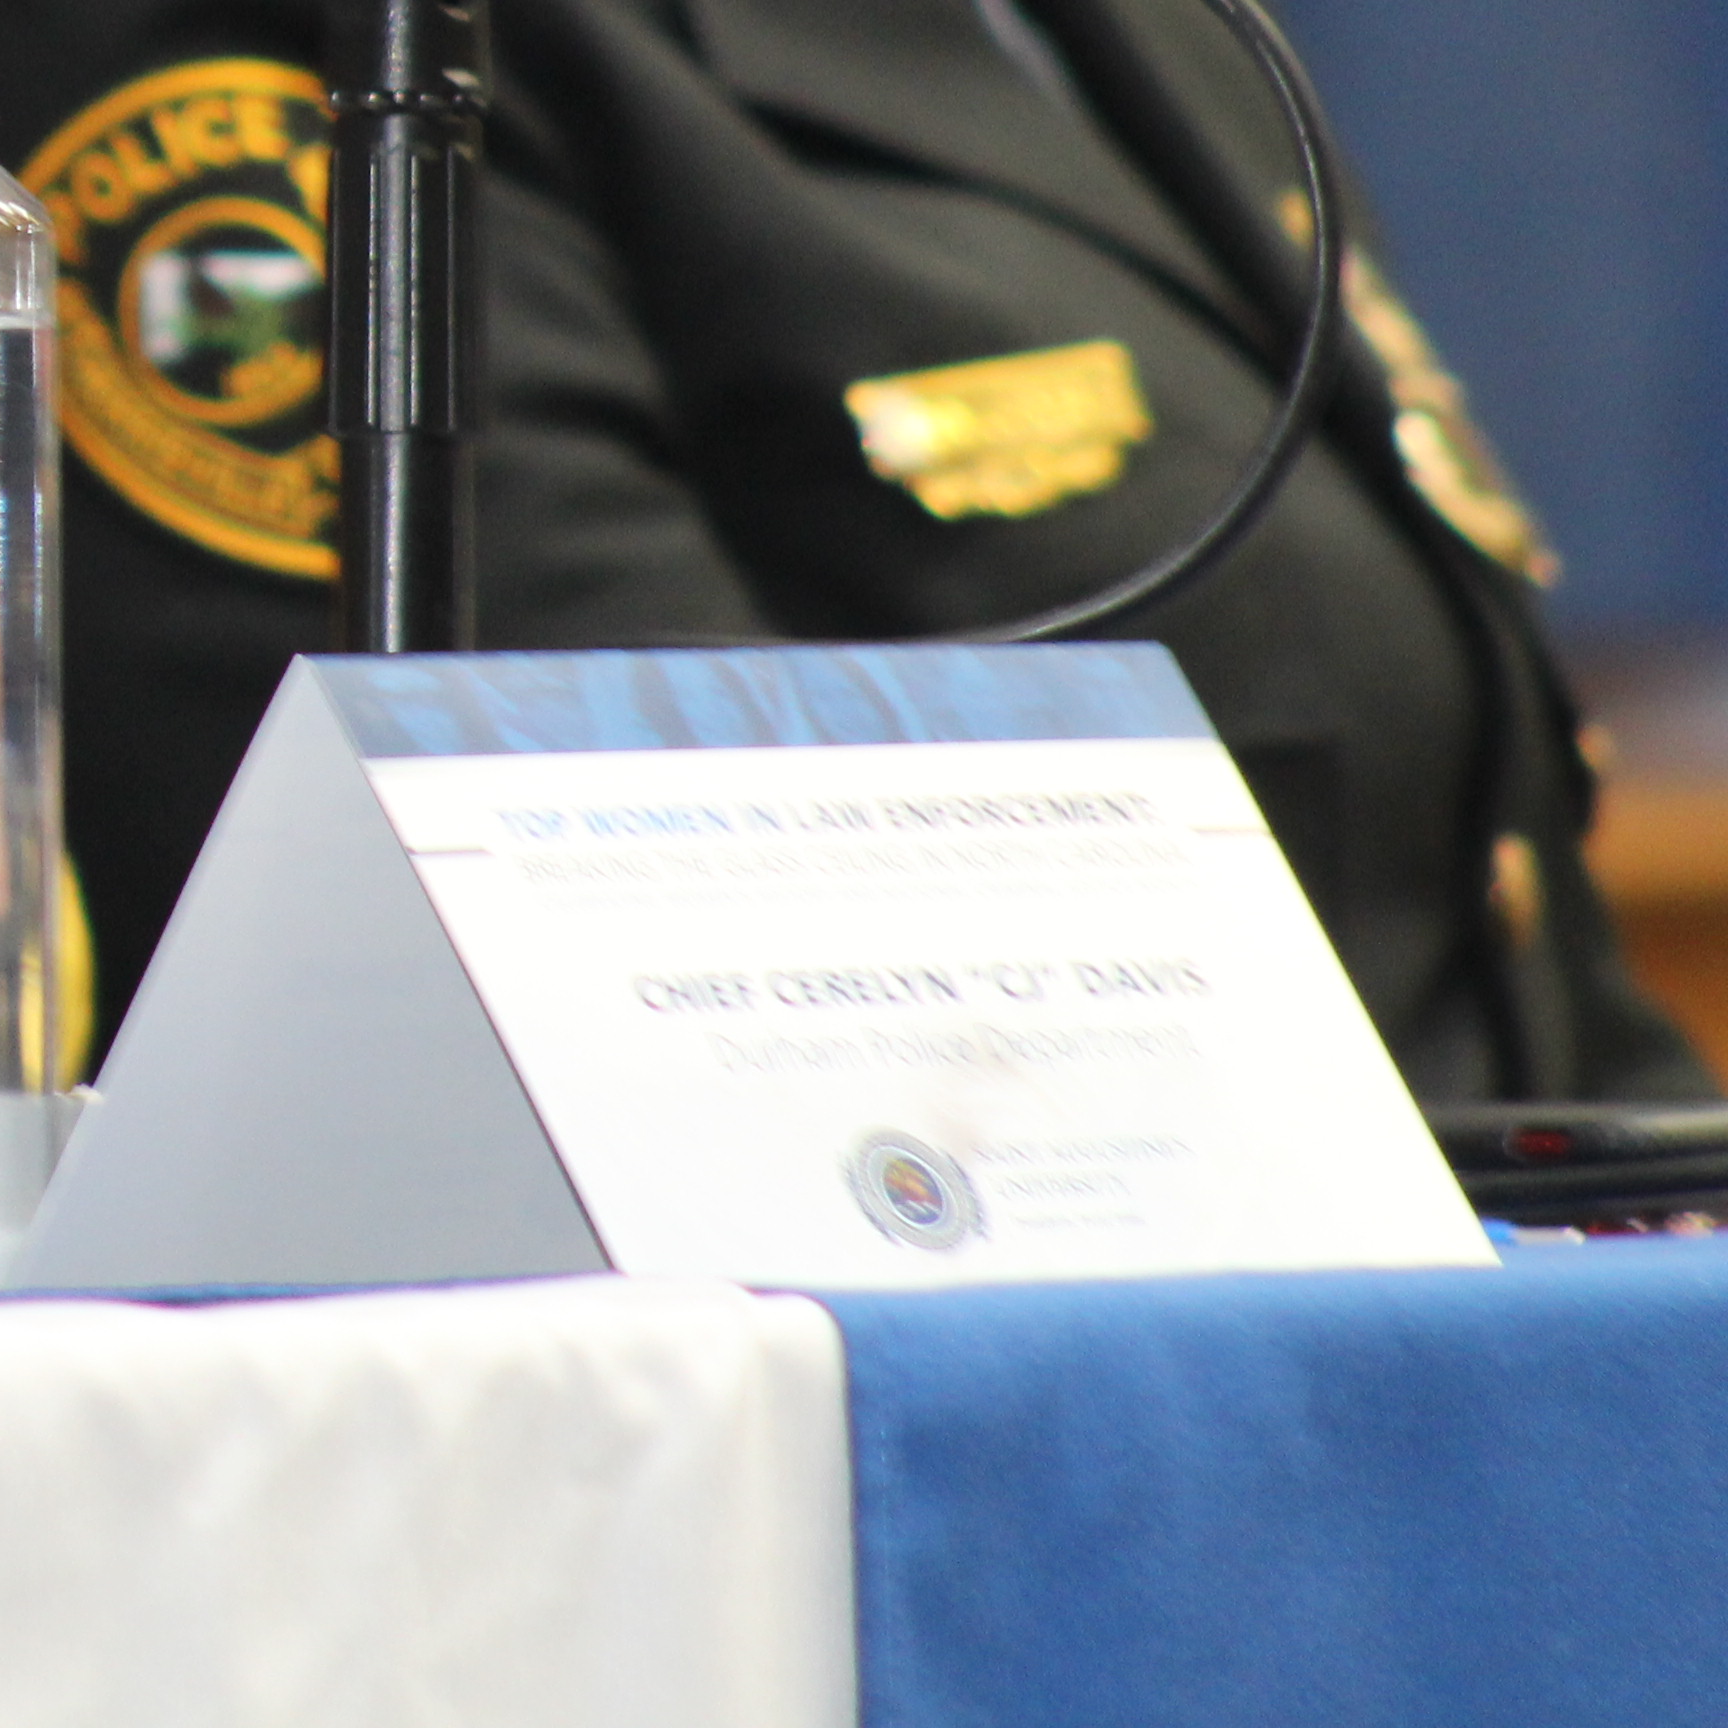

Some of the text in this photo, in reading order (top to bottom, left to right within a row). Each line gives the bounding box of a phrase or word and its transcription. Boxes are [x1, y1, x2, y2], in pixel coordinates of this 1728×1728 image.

[42, 94, 289, 264] POLICE
[496, 789, 1163, 840] TOP WOMEN IN LAW ENFORCEMENT
[630, 968, 758, 1014] CHIEF
[761, 963, 967, 1009] CERELYN
[1064, 955, 1214, 999] DAVIS
